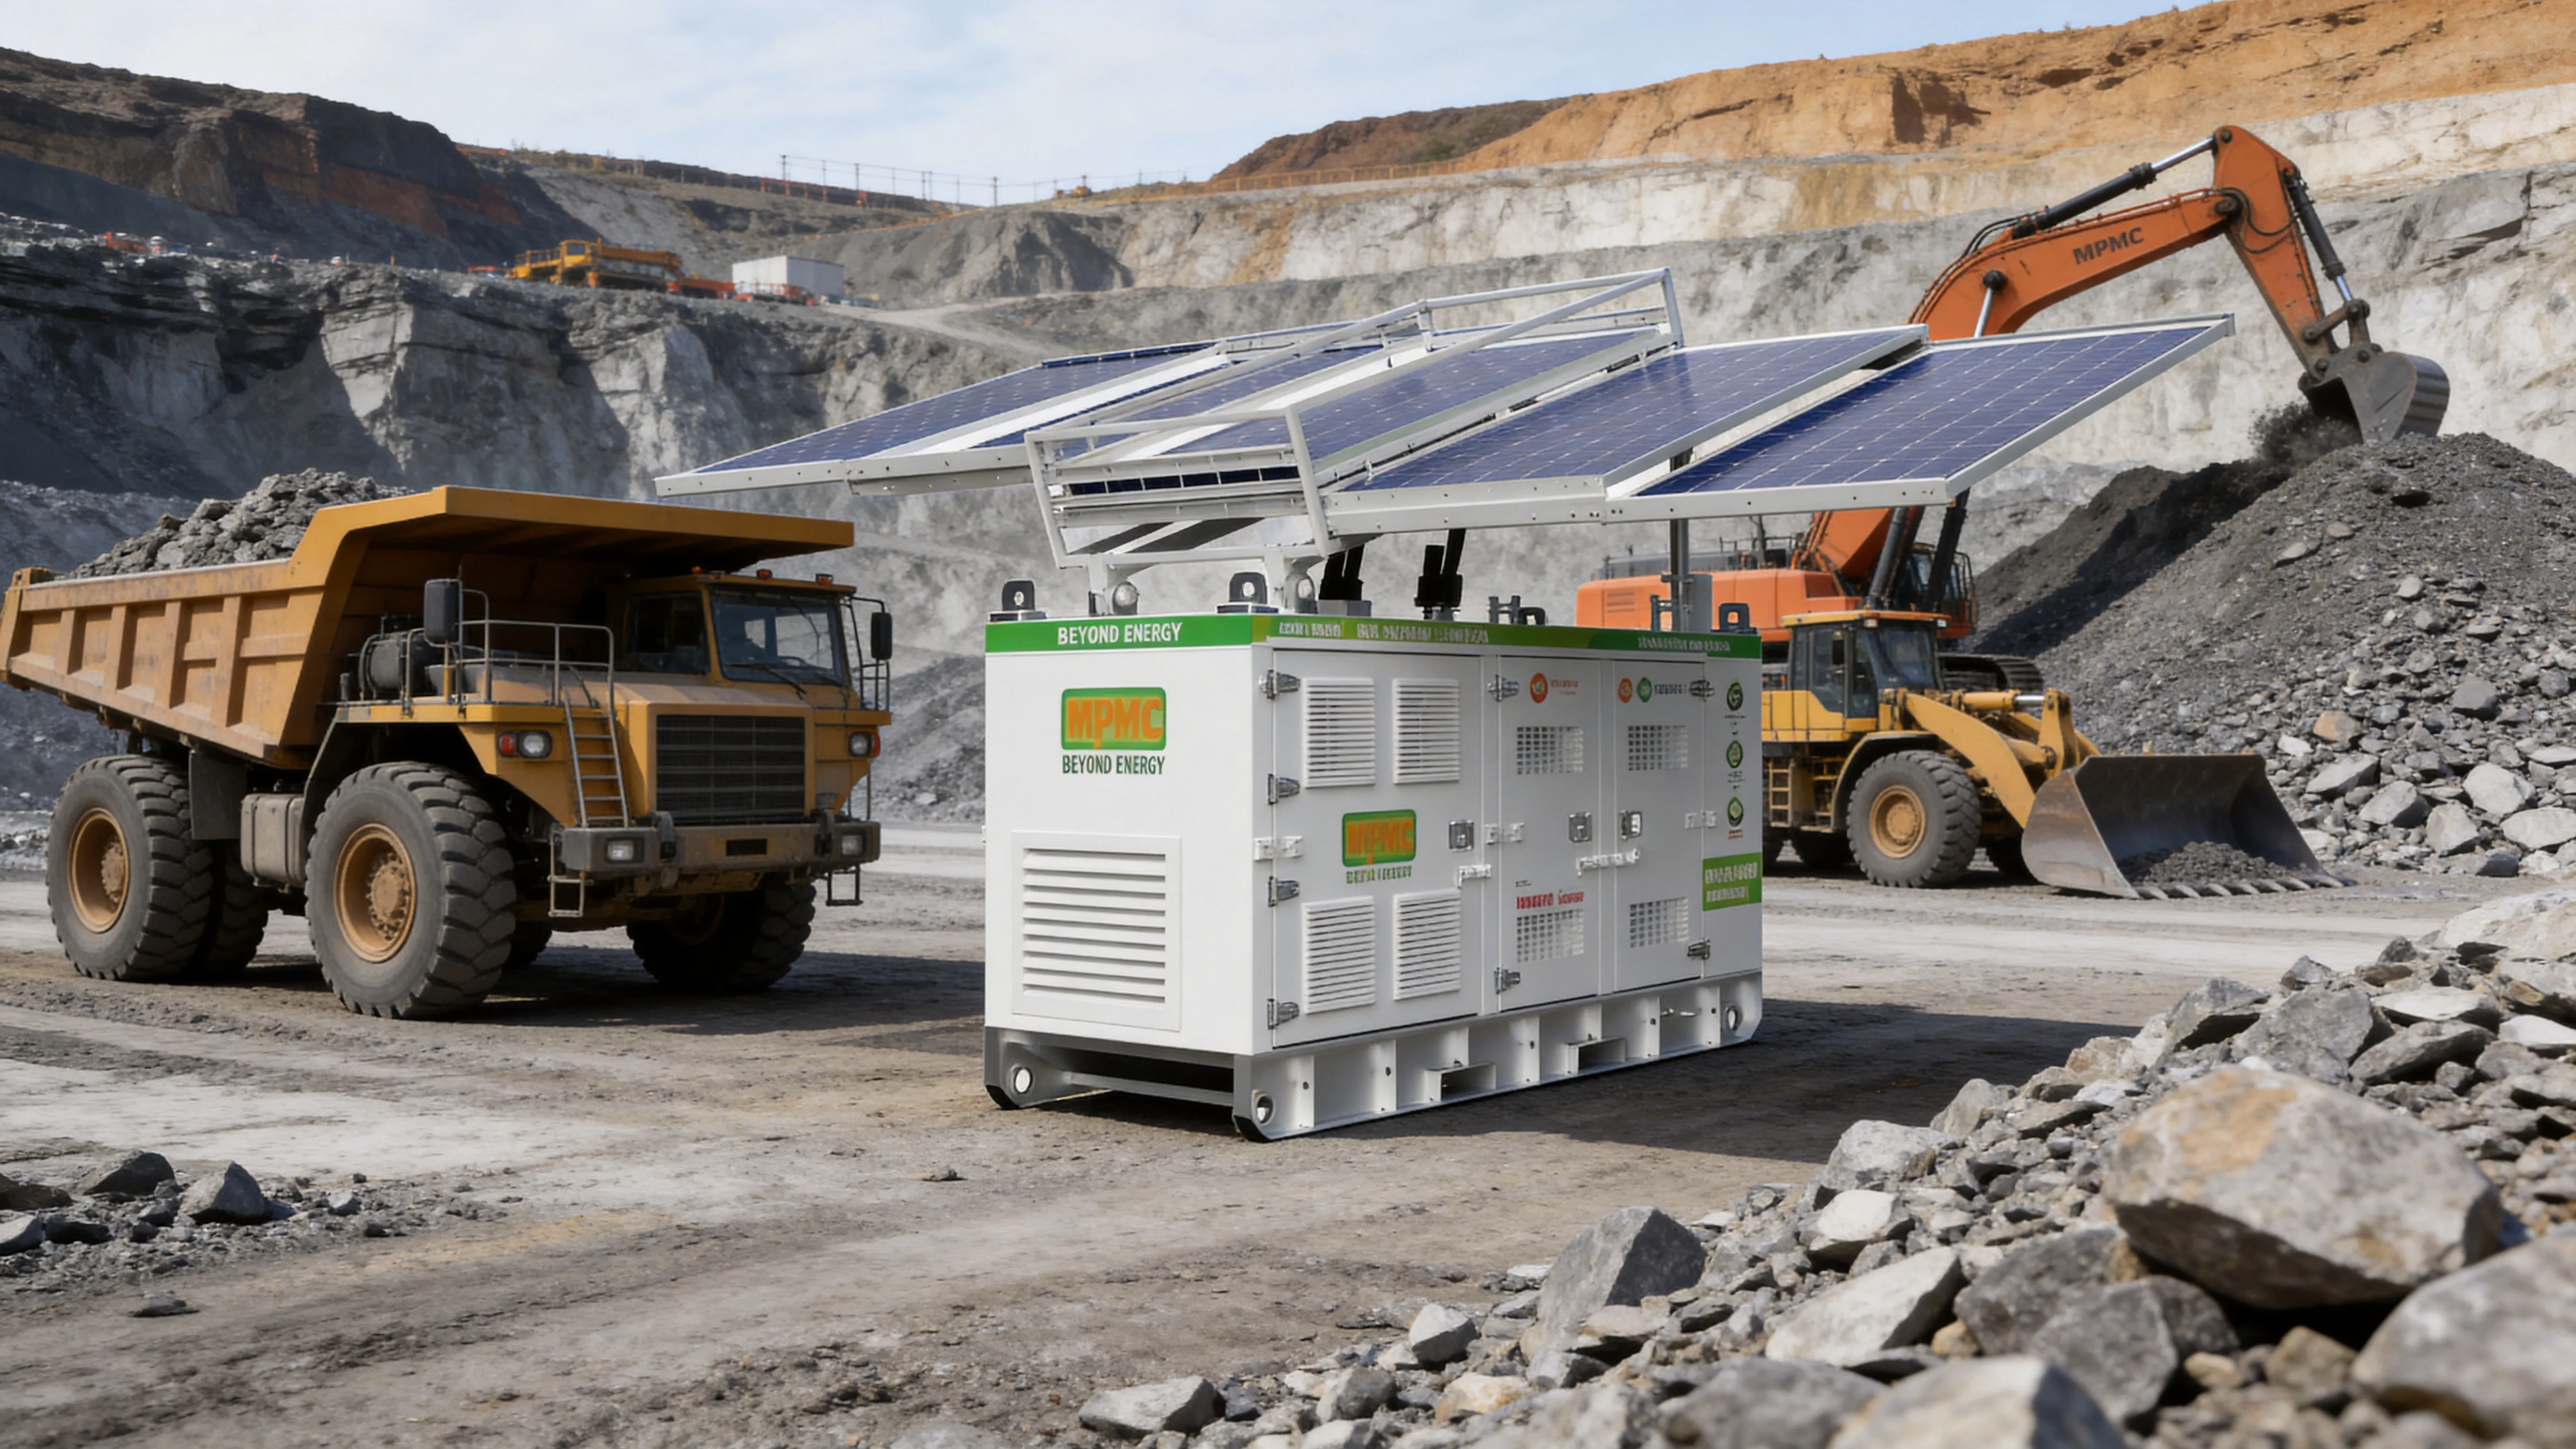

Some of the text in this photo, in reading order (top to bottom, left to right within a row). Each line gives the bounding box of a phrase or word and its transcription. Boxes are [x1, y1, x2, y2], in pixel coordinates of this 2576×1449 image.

[2073, 227, 2145, 265] MPMC
[1058, 622, 1182, 645] BEYOND ENERGY
[1068, 698, 1162, 748] MPMC
[1063, 755, 1165, 774] BEYOND ENERGY
[1348, 820, 1413, 864] MPMC
